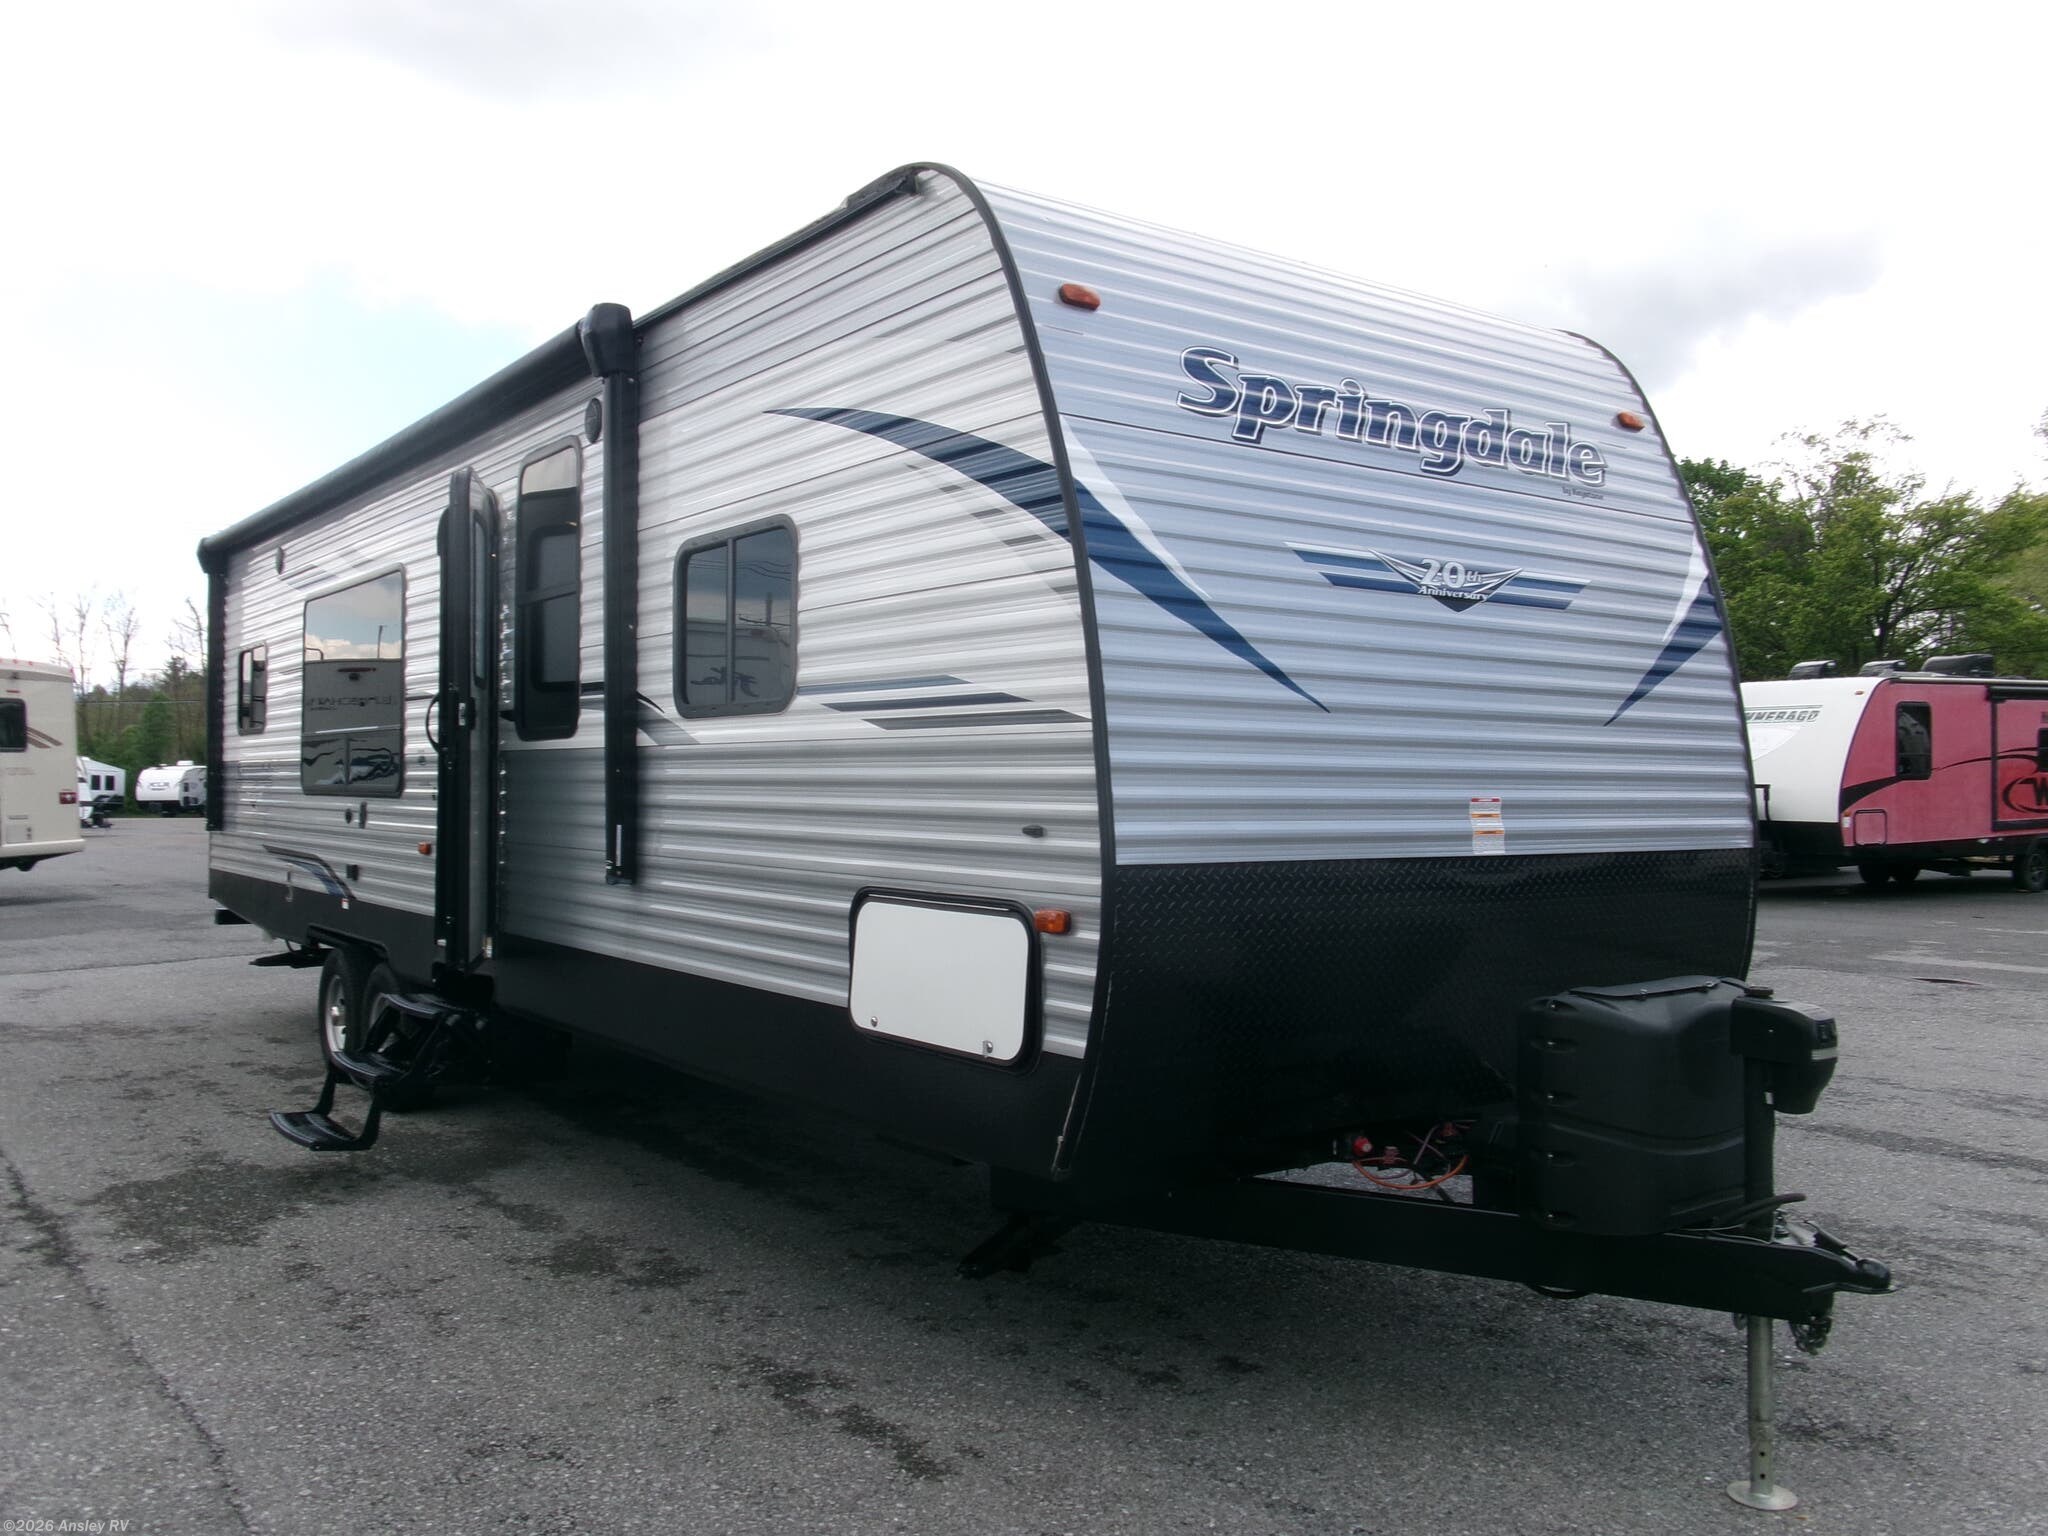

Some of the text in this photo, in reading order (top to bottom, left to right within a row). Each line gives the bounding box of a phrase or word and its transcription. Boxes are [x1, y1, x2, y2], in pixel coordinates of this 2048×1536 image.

[1176, 345, 1607, 486] Springdale
[1420, 558, 1482, 588] 20th
[1418, 587, 1489, 602] Anniversary
